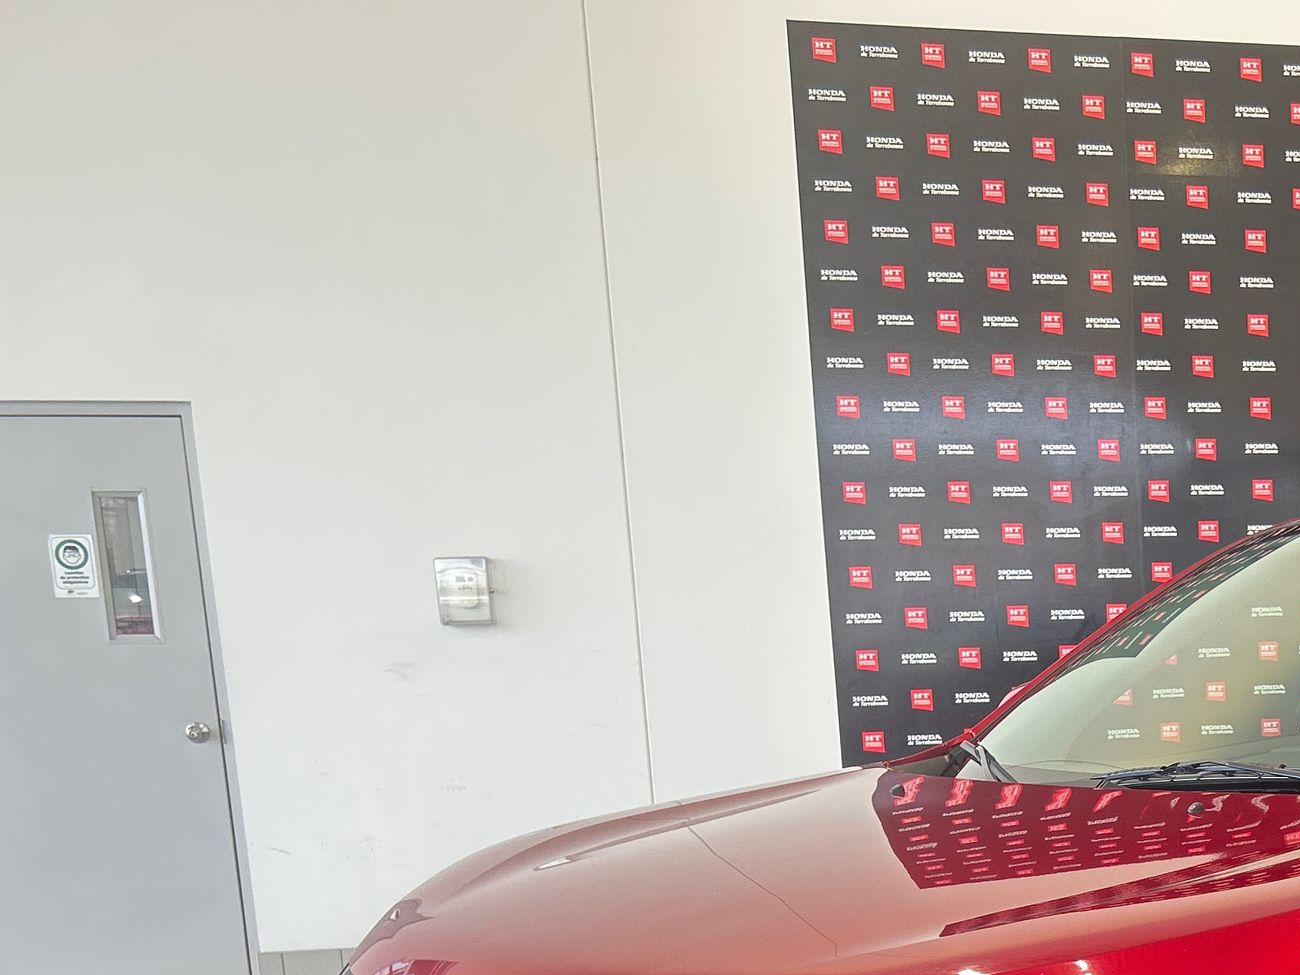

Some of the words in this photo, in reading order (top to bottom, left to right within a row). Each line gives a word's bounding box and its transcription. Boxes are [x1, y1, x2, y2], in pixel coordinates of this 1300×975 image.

[860, 45, 898, 53] HONDA
[1074, 55, 1109, 63] HONDA
[917, 93, 954, 101] HONDA
[1126, 101, 1161, 109] HONDA
[866, 136, 903, 144] HONDA
[973, 140, 1009, 148] HONDA
